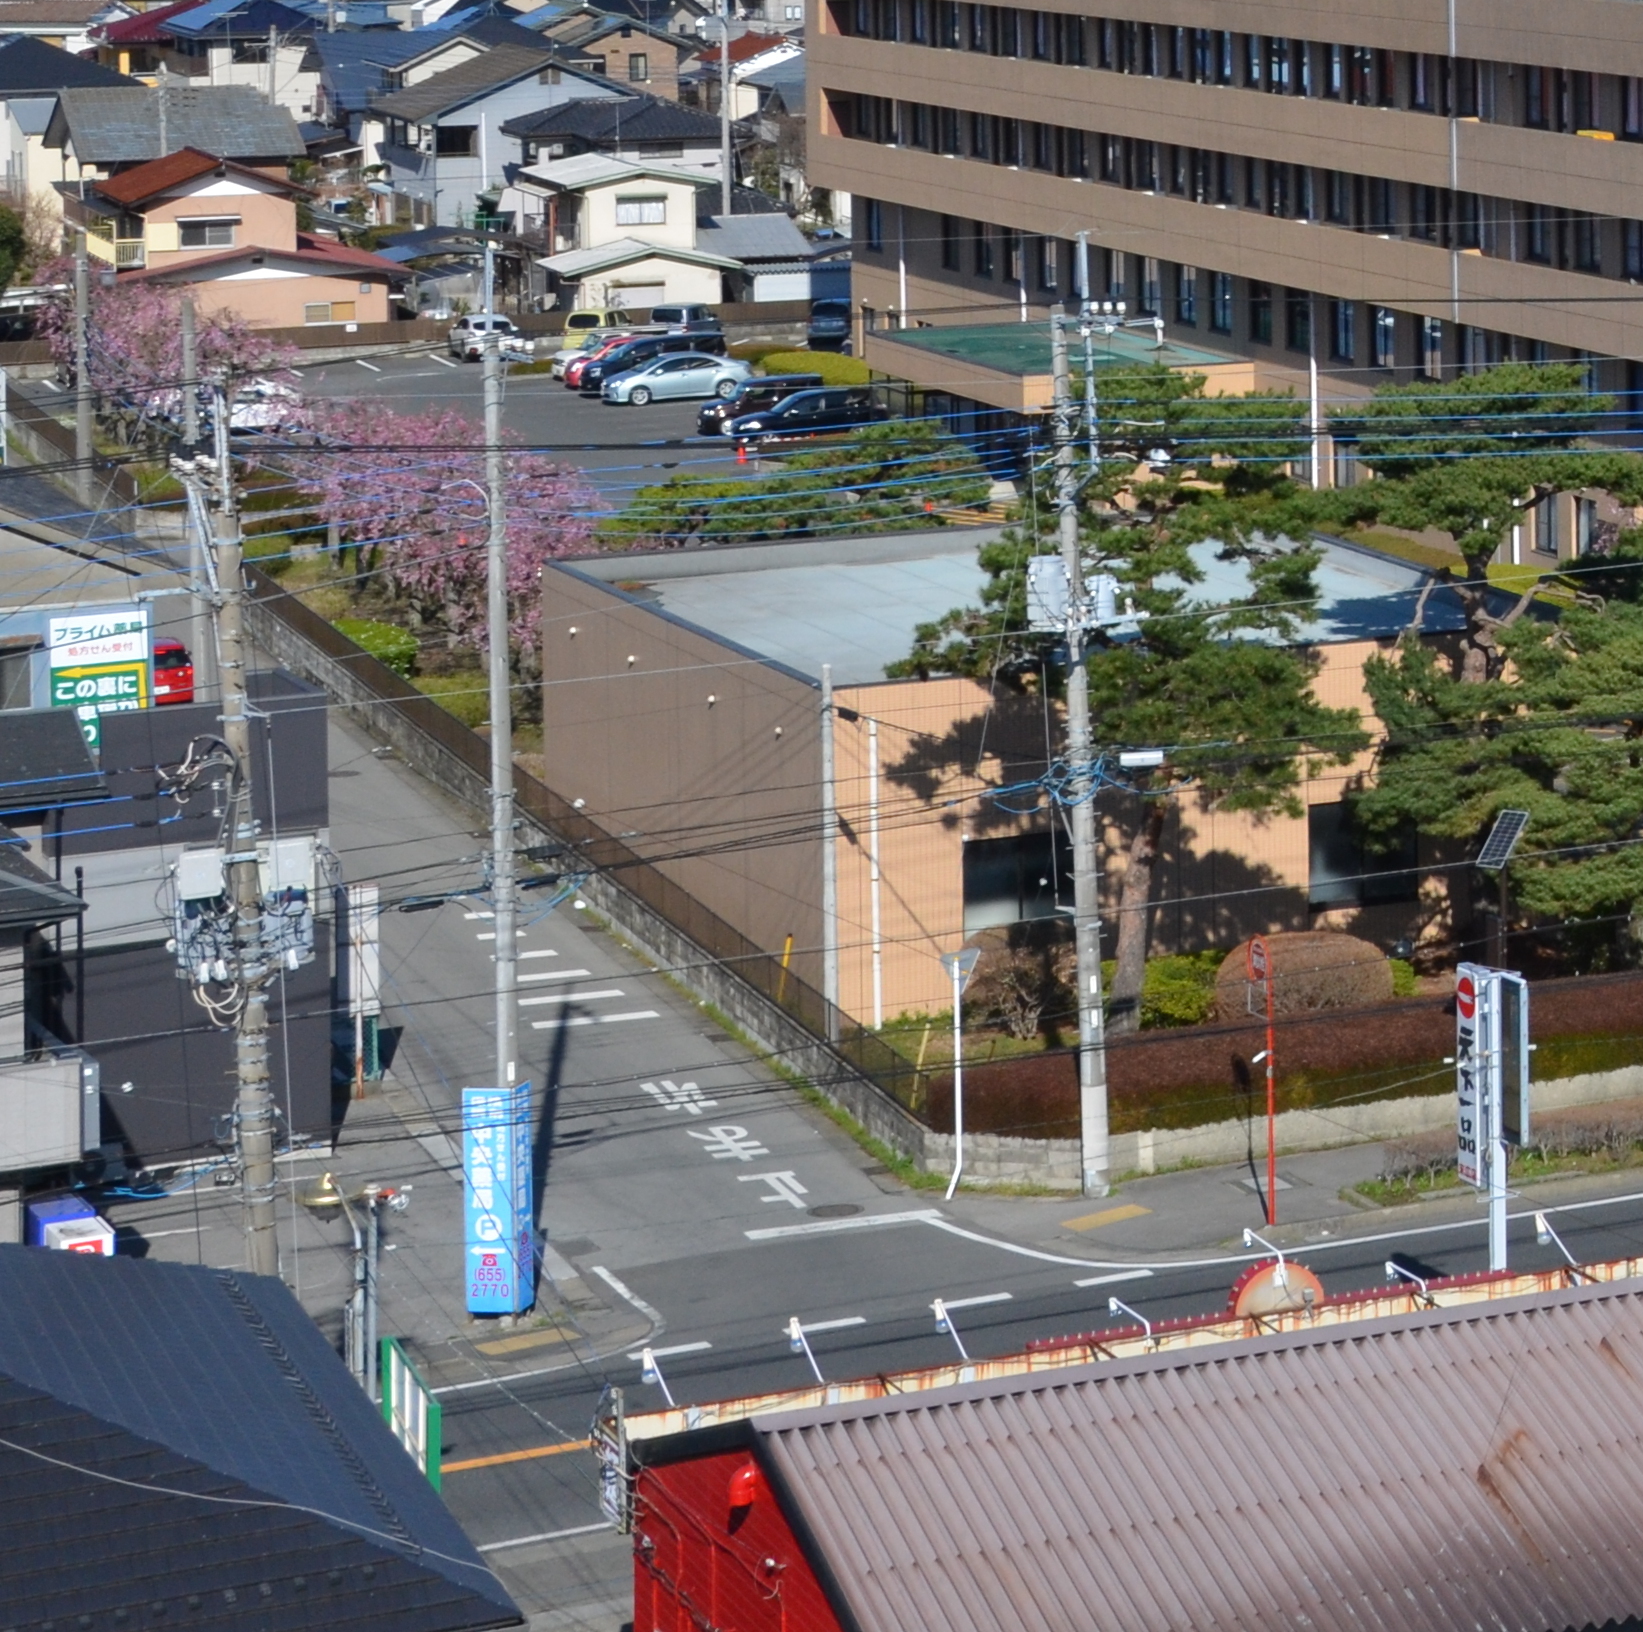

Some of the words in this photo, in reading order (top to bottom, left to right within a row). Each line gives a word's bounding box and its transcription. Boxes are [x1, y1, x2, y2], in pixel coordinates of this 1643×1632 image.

[1458, 1025, 1476, 1156] 天下一品
[470, 1123, 493, 1210] 中央薬局
[471, 1283, 509, 1298] 2770
[474, 1268, 506, 1282] (655)
